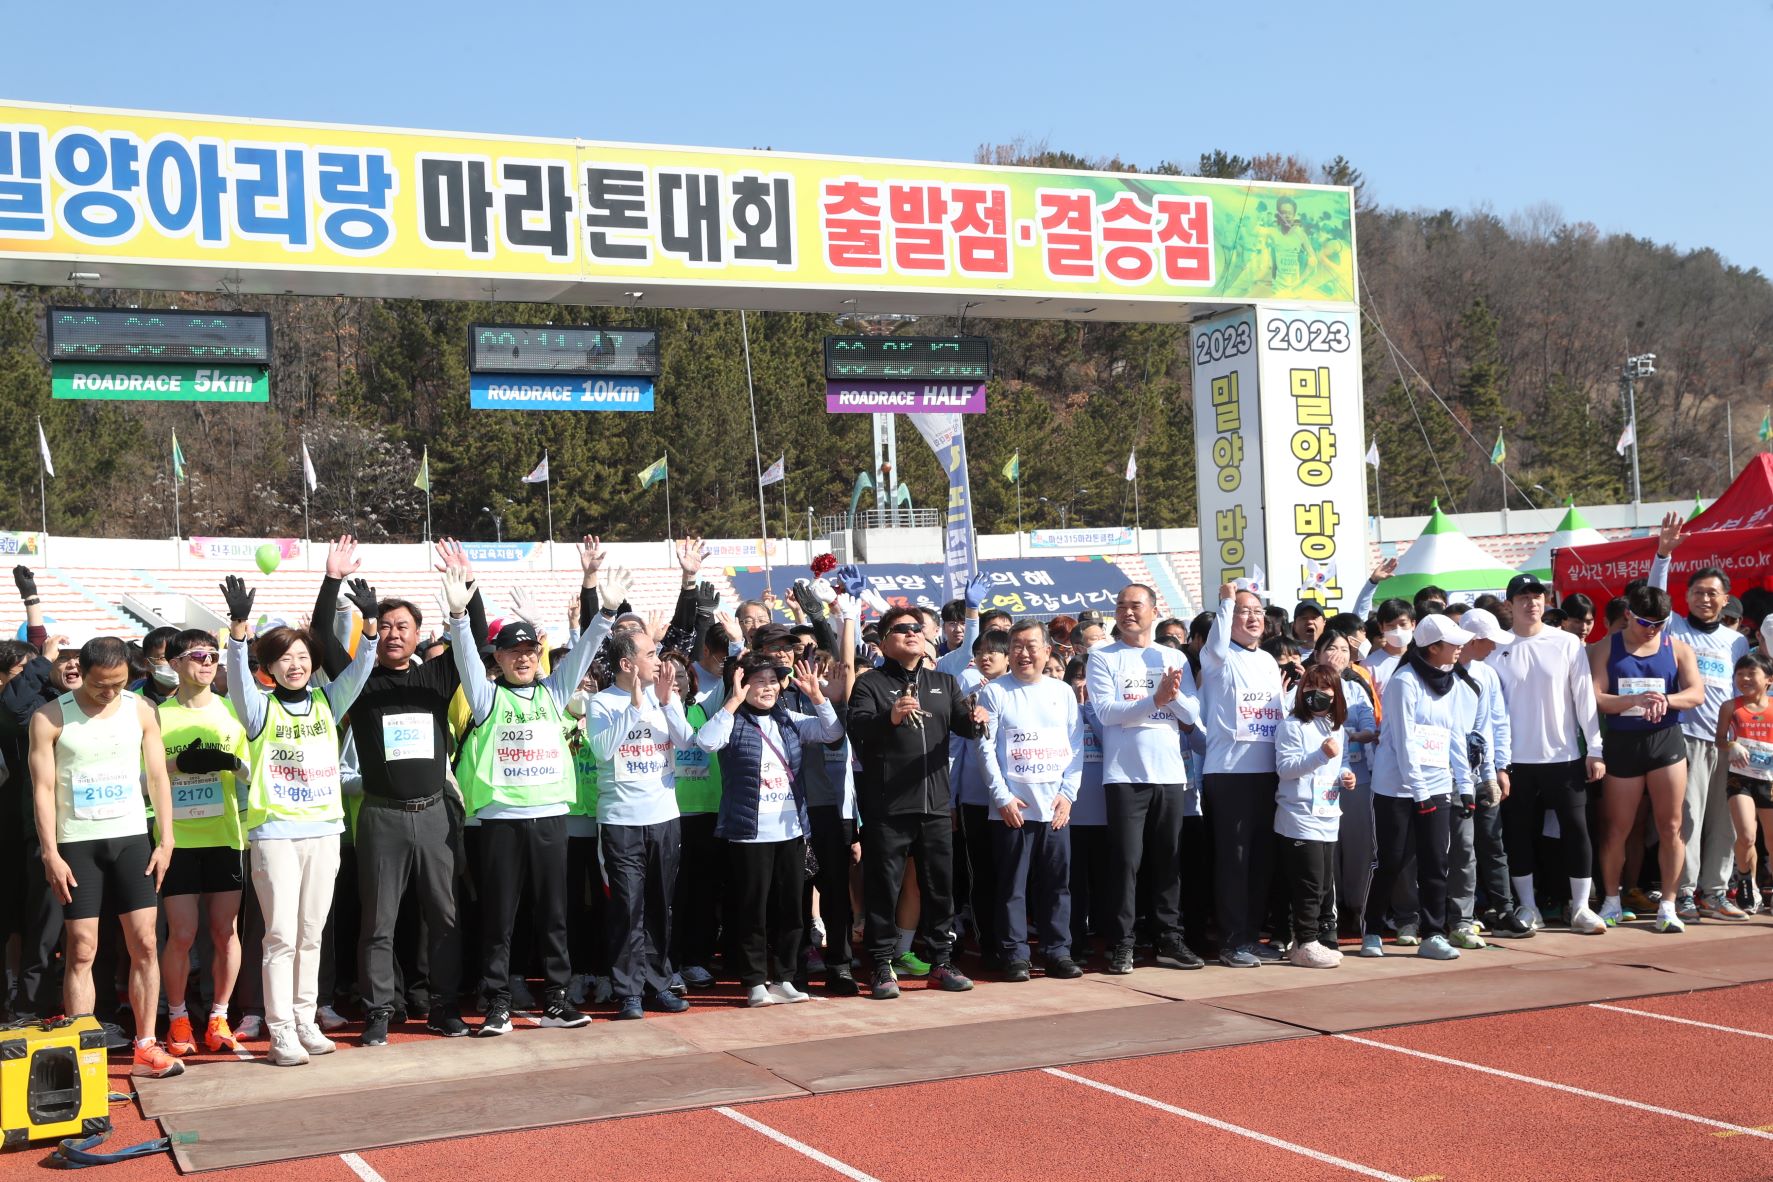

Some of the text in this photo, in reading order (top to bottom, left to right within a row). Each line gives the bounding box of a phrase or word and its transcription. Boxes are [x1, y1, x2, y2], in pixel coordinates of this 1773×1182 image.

[0, 129, 1210, 281] 밀양아리랑 마라톤대회 출발점·결승점
[1267, 318, 1350, 352] 2023
[1197, 321, 1251, 365] 2023
[72, 370, 253, 392] ROADRACE 5km
[488, 381, 640, 402] ROADRACE 10km
[839, 386, 974, 406] ROADRACE HALF
[1211, 370, 1243, 493] 밀양
[1290, 366, 1337, 487] 밀양
[465, 549, 524, 560] 양교육지원청
[1021, 570, 1055, 585] 해
[1568, 564, 1602, 581] 실시간
[1606, 560, 1651, 578] 기록검색
[867, 575, 927, 591] 밀양
[1697, 660, 1725, 673] 2093
[1124, 678, 1155, 689] 2023
[1243, 691, 1272, 702] 2023
[501, 729, 533, 741] 2023
[625, 728, 652, 741] 023
[1013, 732, 1039, 743] 2023
[270, 749, 305, 762] 2023
[677, 750, 703, 761] 2212
[85, 784, 123, 801] 2163
[178, 787, 214, 802] 2170
